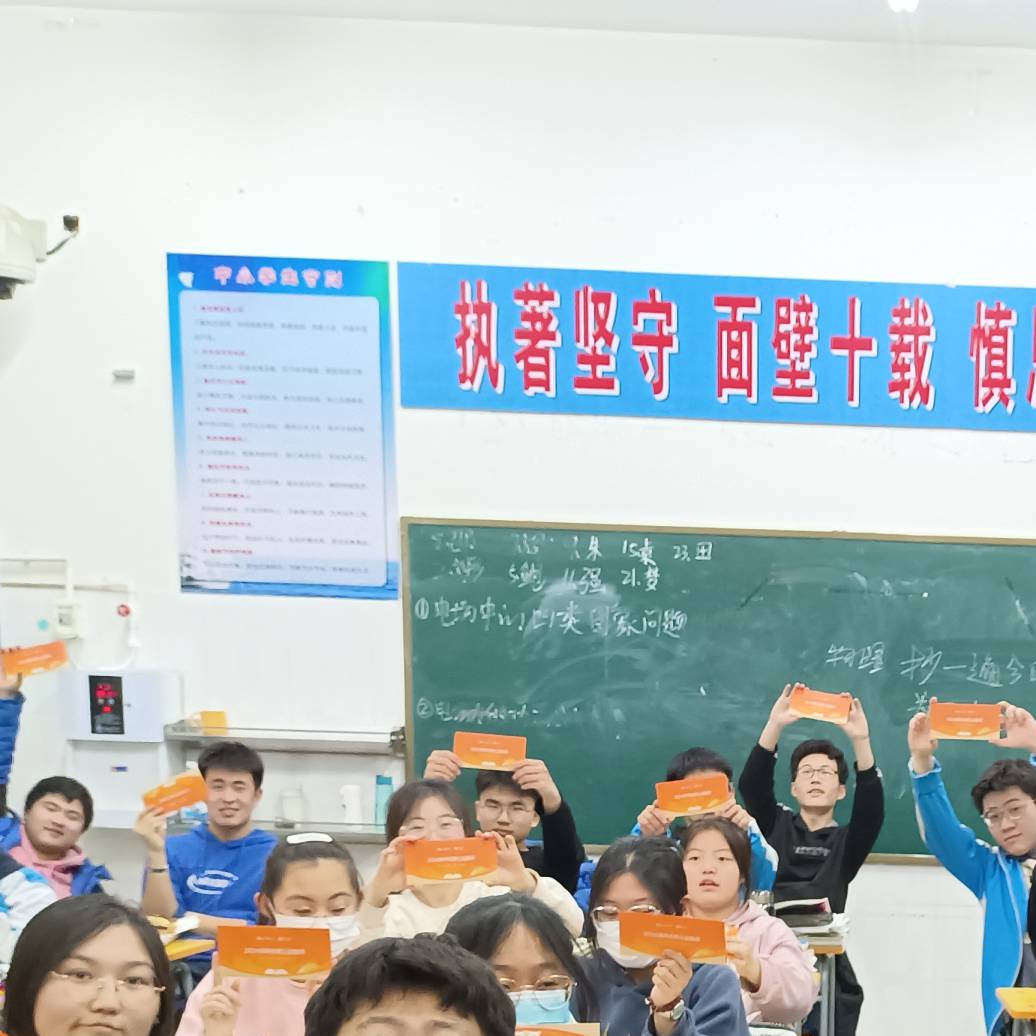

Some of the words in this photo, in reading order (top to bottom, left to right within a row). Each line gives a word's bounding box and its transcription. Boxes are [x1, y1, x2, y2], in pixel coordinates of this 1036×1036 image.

[453, 280, 679, 401] 执著坚守
[713, 293, 936, 410] 面壁十载
[825, 641, 885, 674] 物理
